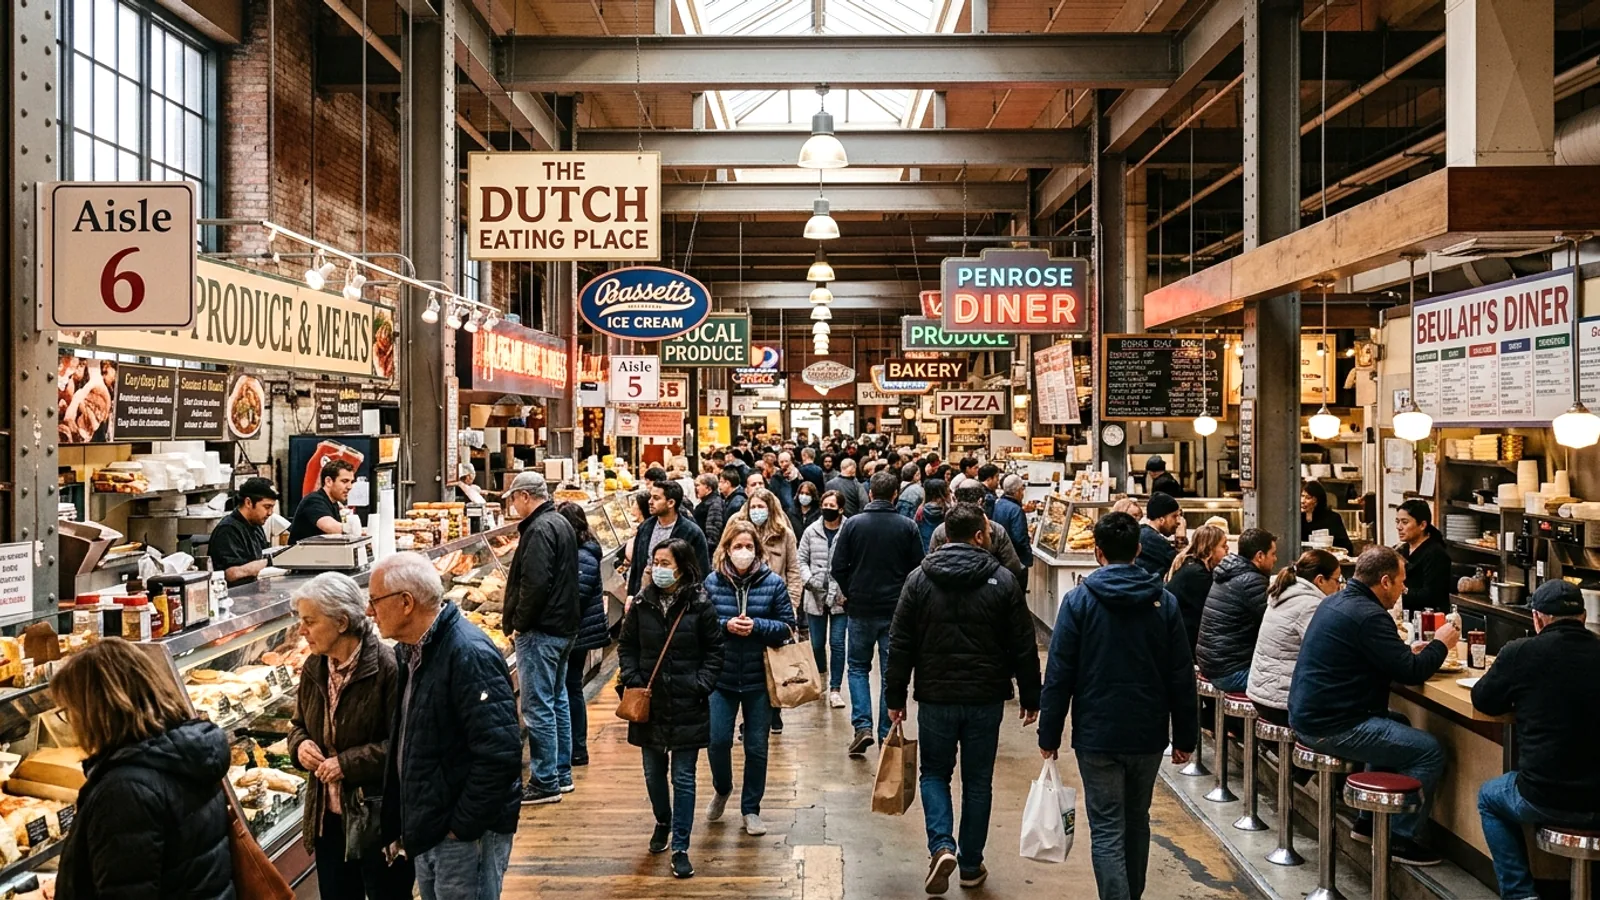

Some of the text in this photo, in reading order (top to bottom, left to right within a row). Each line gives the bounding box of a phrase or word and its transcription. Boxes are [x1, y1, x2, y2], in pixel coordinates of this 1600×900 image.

[542, 161, 586, 180] THE
[479, 186, 649, 223] DUTCH
[71, 198, 172, 232] Aisle
[479, 229, 649, 249] EATING PLACE
[100, 246, 146, 313] 6
[958, 267, 1073, 287] PENROSE
[954, 294, 1077, 324] DINER
[1416, 285, 1569, 344] BEULAH'S DINER
[298, 300, 312, 355] &
[316, 304, 370, 363] MEATS
[607, 316, 683, 329] ICE CREAM
[671, 323, 742, 343] OCAL
[665, 345, 744, 361] PRODUCE
[618, 361, 652, 373] Aisle
[889, 363, 962, 378] BAKERY
[627, 376, 643, 398] 5
[940, 395, 1000, 411] PIZZA
